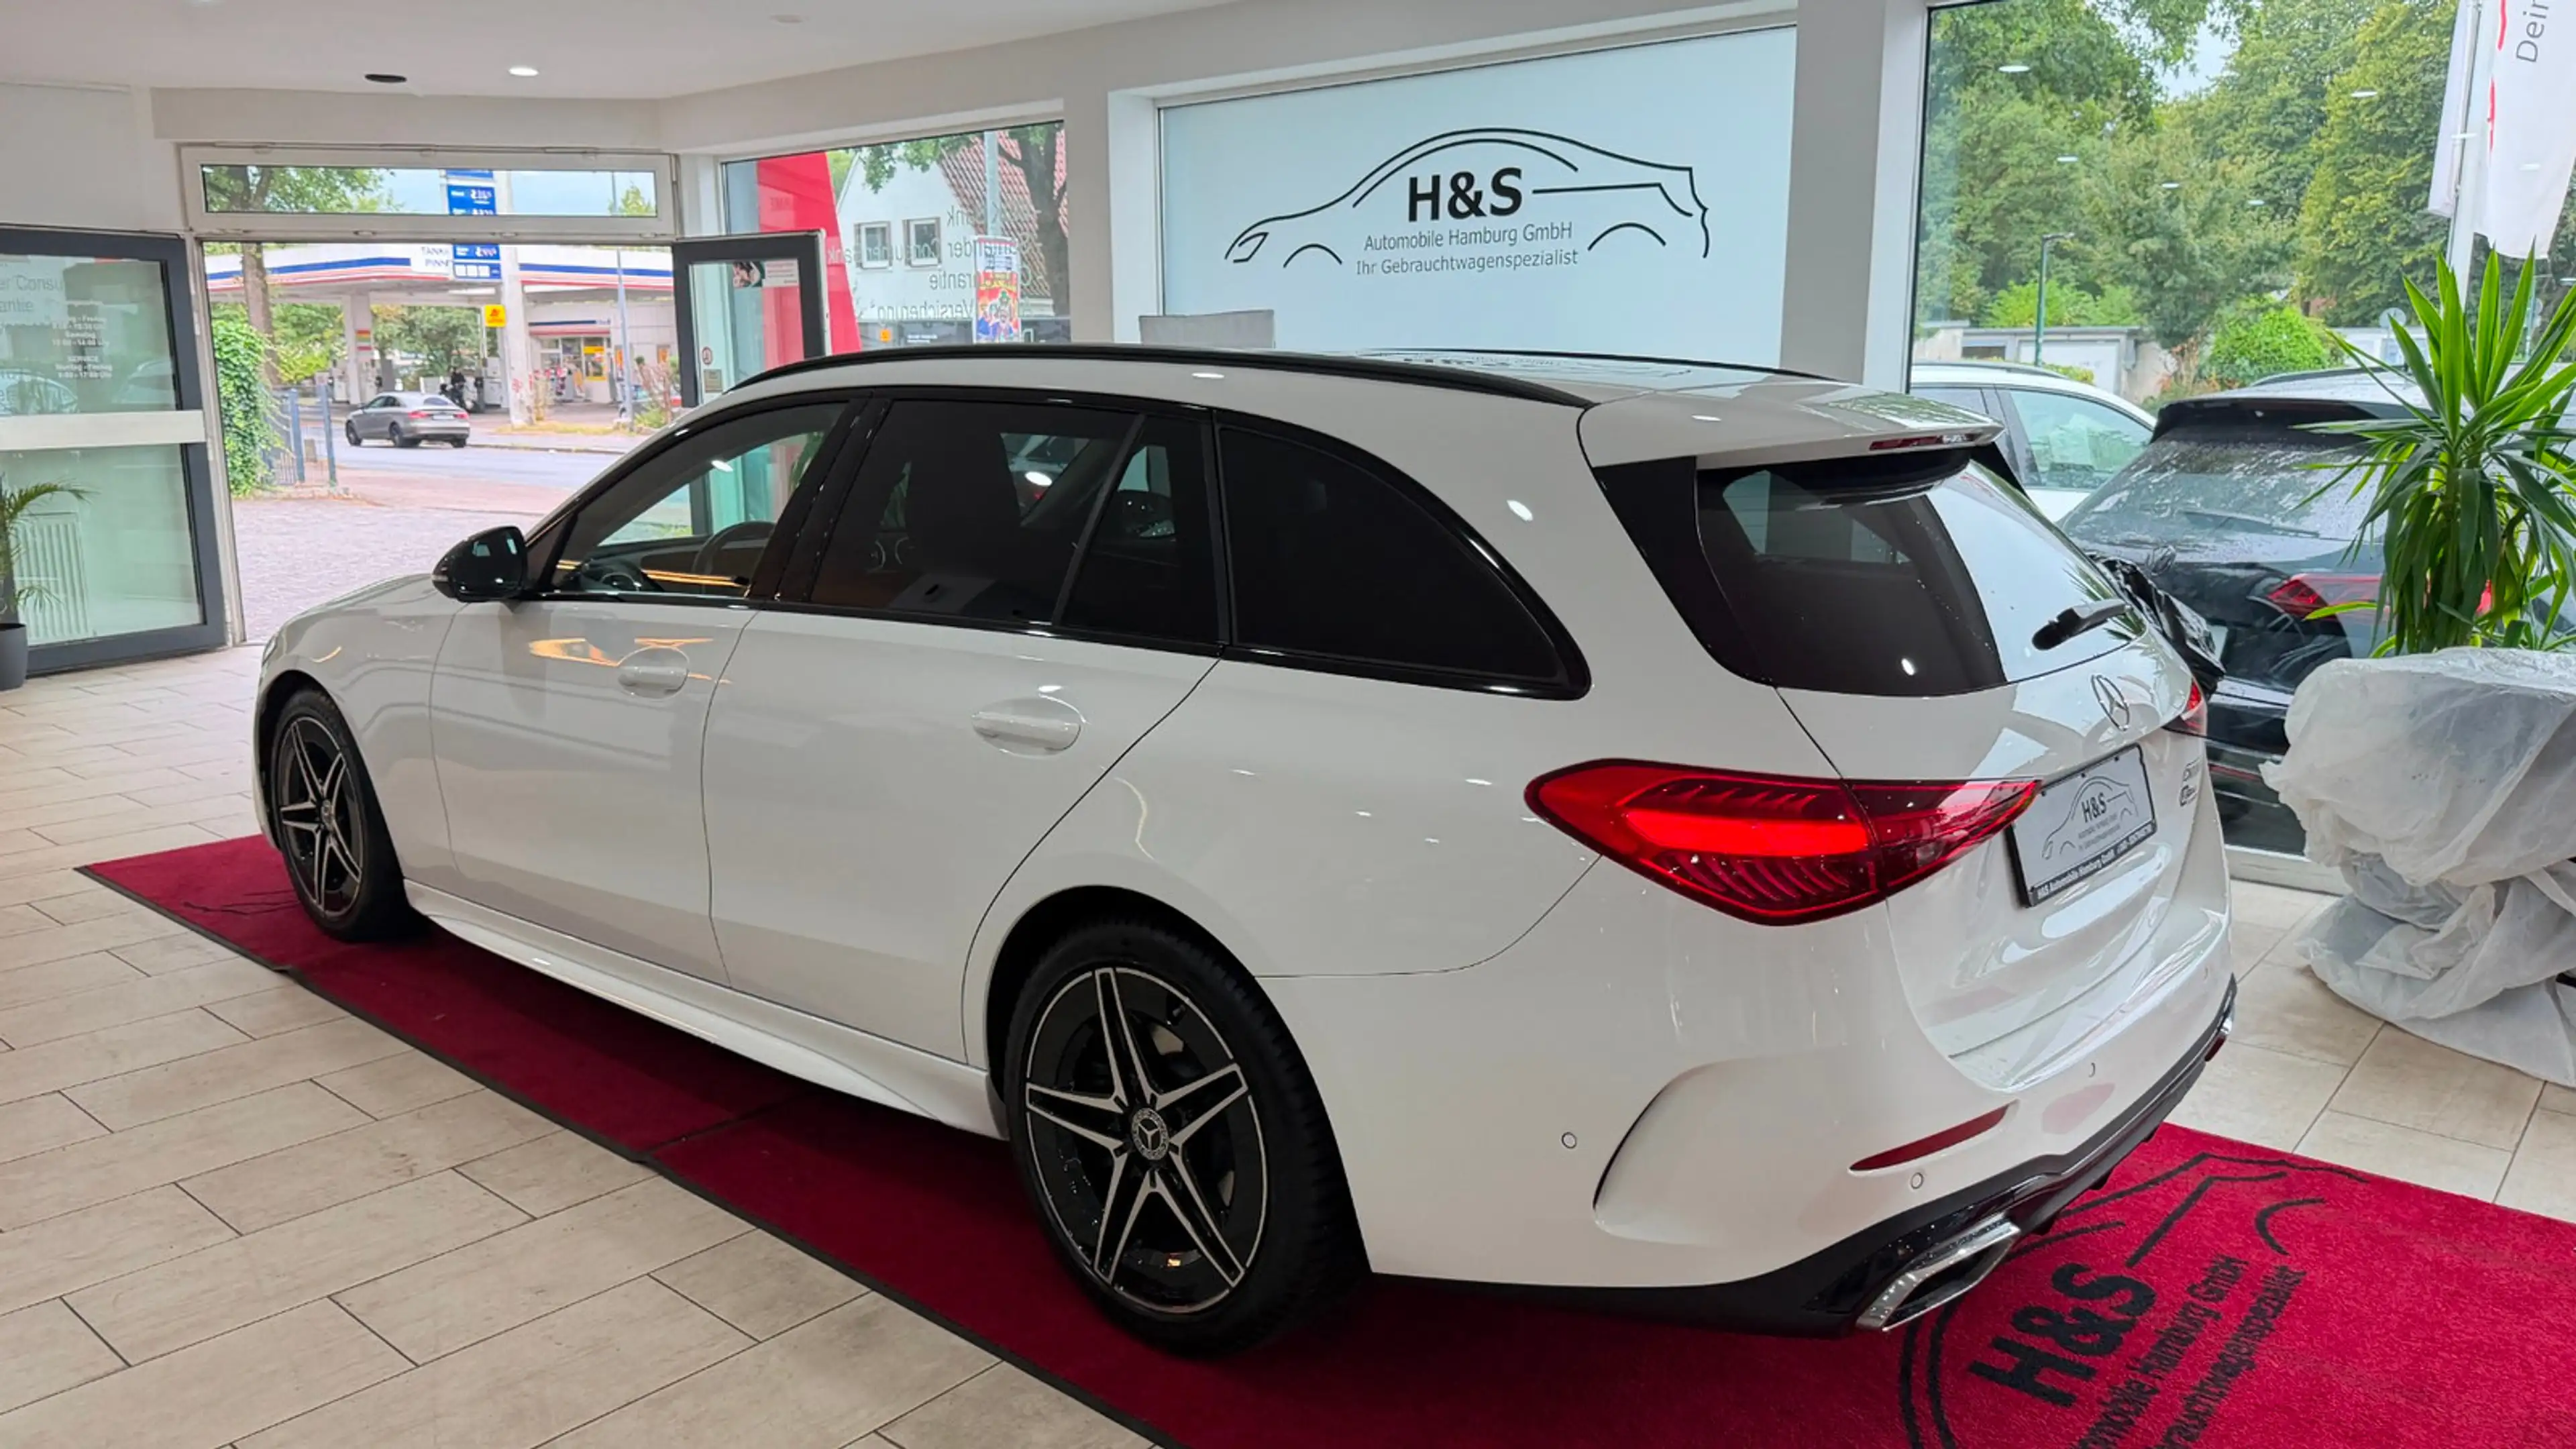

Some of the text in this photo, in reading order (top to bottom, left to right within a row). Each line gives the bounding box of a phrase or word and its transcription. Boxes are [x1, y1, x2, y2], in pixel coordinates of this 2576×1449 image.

[1409, 167, 1523, 222] H&S
[1364, 221, 1573, 251] Automobile Hamburg GmbH
[1356, 249, 1578, 276] Ihr Gebrauchtwagenspezialist
[2081, 792, 2108, 823] H&S
[1968, 1263, 2158, 1407] H&S
